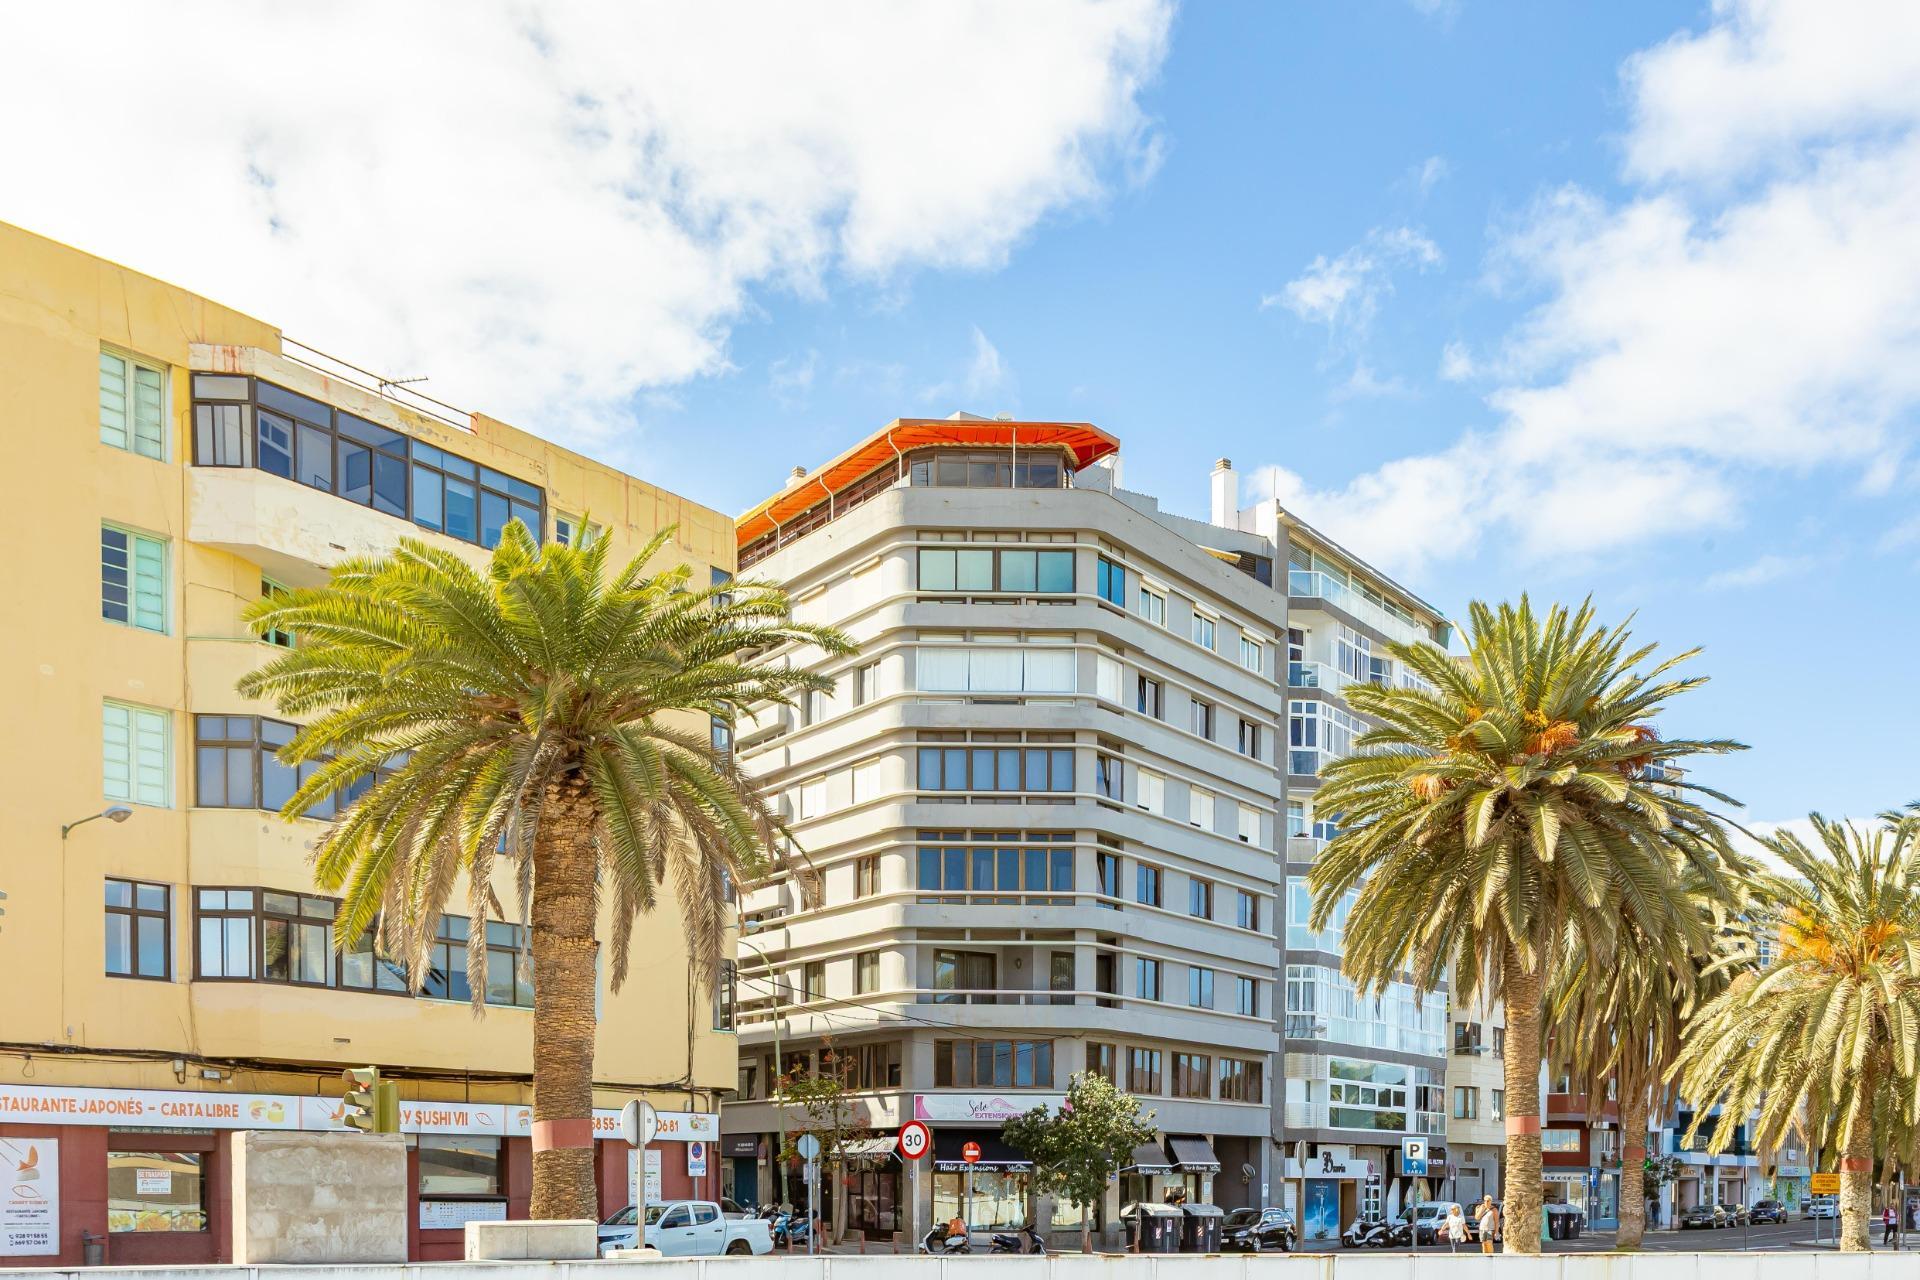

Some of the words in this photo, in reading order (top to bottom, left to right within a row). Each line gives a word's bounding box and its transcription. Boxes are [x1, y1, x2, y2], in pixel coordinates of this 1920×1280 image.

[0, 1096, 77, 1113] TAURANTE
[79, 1097, 143, 1115] JAPONÉS
[161, 1102, 203, 1117] CARTA
[206, 1104, 239, 1118] LIBRE
[415, 1110, 451, 1125] SUSHI
[453, 1111, 468, 1126] VII
[603, 1117, 615, 1131] 55
[669, 1120, 679, 1132] 81
[905, 1134, 921, 1147] 30
[1410, 1144, 1420, 1157] P
[940, 1163, 956, 1171] Hair
[959, 1163, 998, 1172] Exensions
